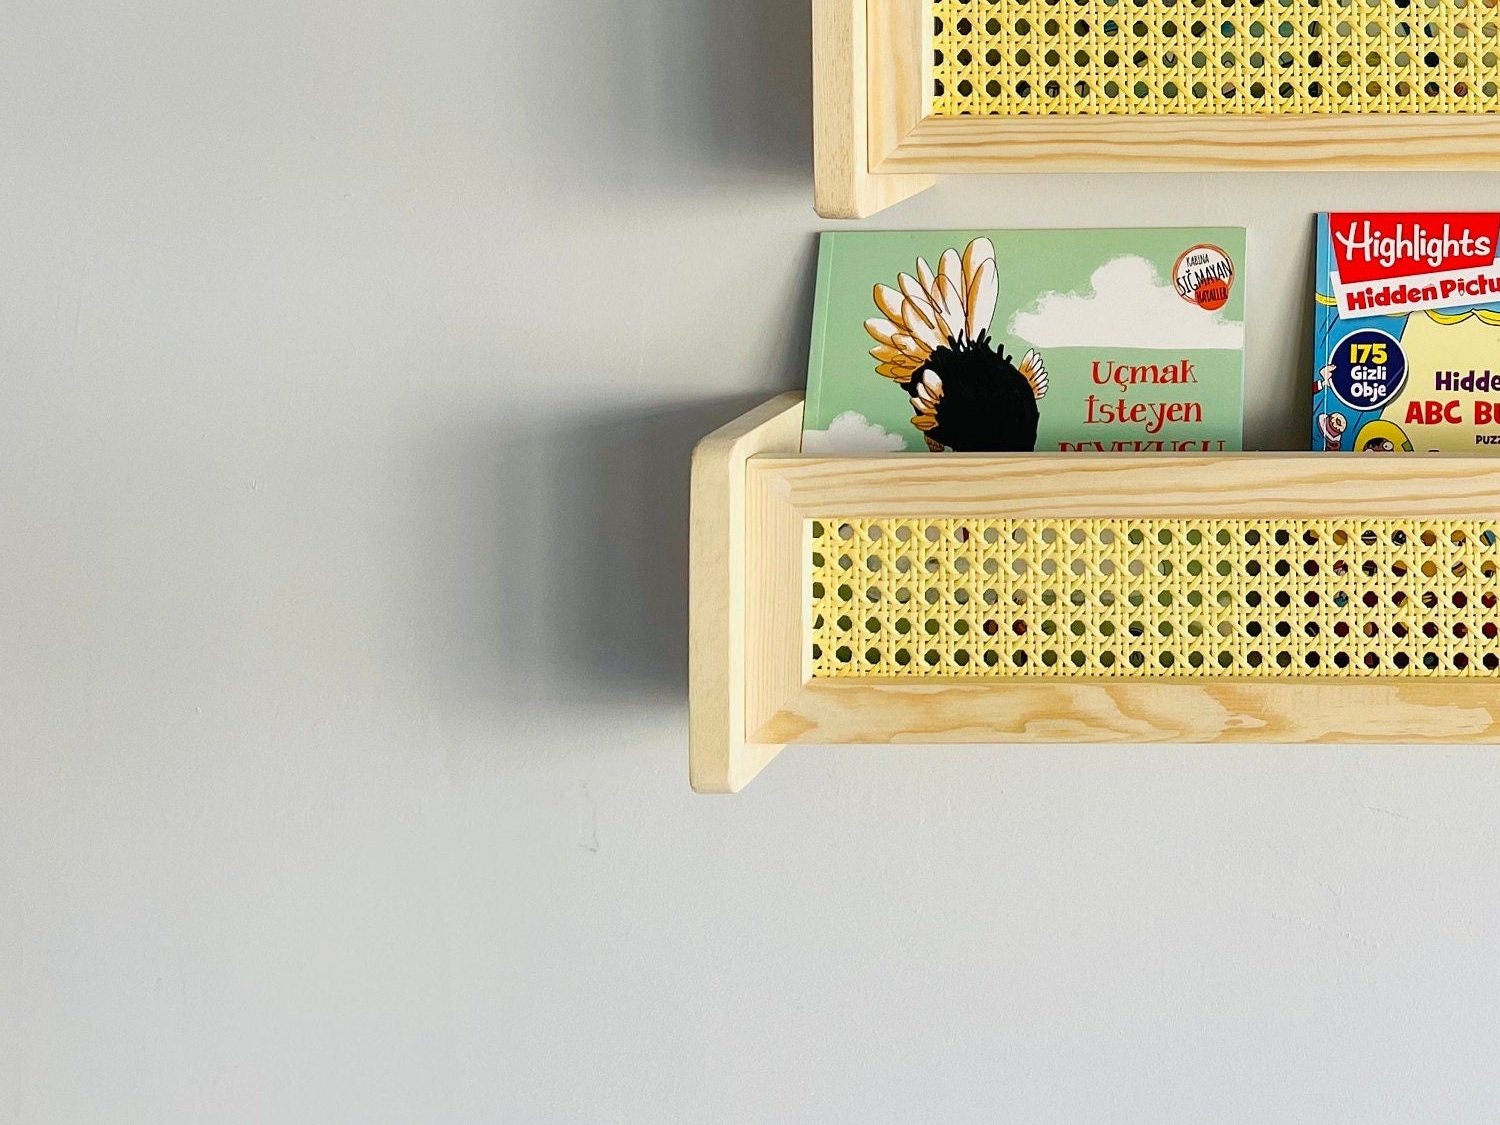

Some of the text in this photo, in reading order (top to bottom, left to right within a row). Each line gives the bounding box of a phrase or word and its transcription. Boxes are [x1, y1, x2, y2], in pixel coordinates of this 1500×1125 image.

[1335, 220, 1491, 268] Highlights
[1176, 257, 1233, 297] SIĞMAYAN
[1346, 284, 1438, 311] Hidden
[1350, 343, 1388, 365] 175
[1092, 359, 1198, 393] Uçmak
[1350, 365, 1387, 381] Gizli
[1350, 381, 1387, 403] Obje
[1083, 394, 1202, 434] İsteyen
[1405, 400, 1463, 425] ABC
